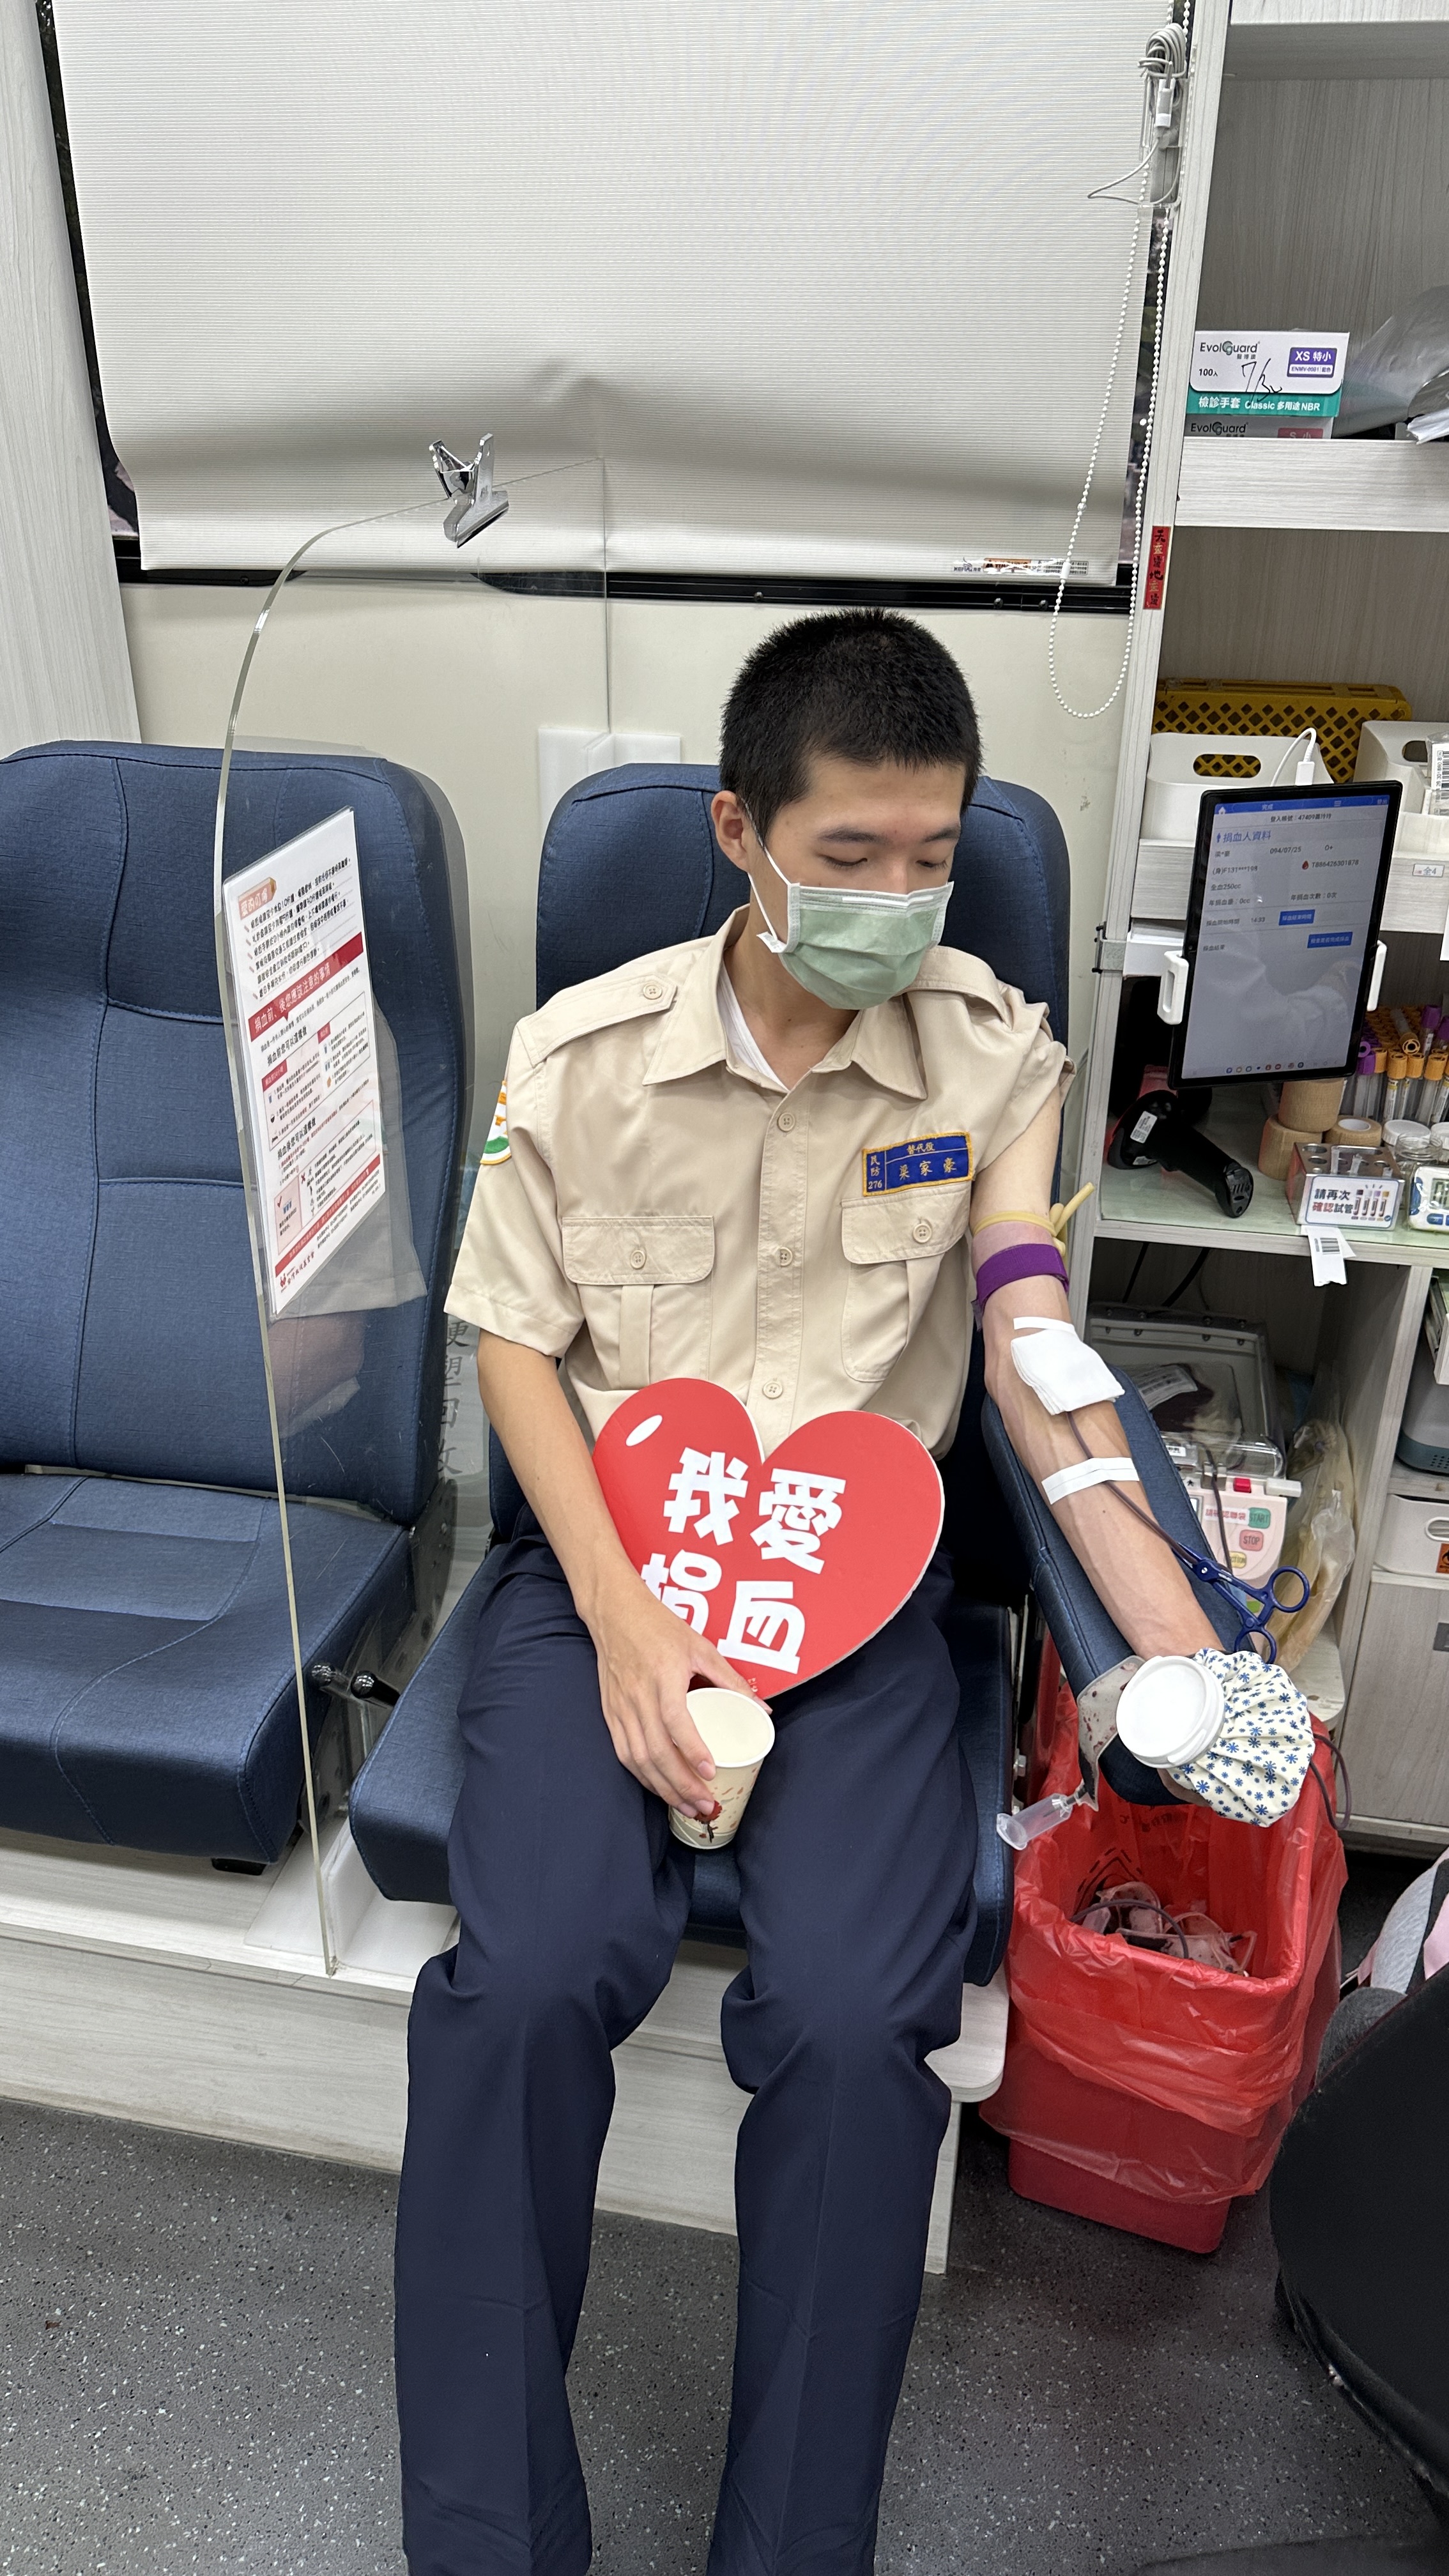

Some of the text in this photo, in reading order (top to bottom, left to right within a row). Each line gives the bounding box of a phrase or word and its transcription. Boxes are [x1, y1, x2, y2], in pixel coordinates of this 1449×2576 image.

[1200, 341, 1257, 355] EvolGuard
[1294, 351, 1331, 362] XS 特小
[1199, 396, 1241, 409] 檢診手套
[1245, 401, 1275, 410] Classic
[1190, 421, 1246, 436] EvolGuard
[1222, 830, 1271, 843] 捐血人資料
[1269, 846, 1301, 854] 094/07/25
[907, 1142, 935, 1155] 替代役
[870, 1155, 881, 1177] 民防
[899, 1157, 957, 1181] 梁家豪
[868, 1180, 882, 1190] 276
[1314, 1188, 1351, 1200] 請再次
[1312, 1202, 1353, 1214] 確認試管
[663, 1446, 847, 1574] 我愛
[1250, 1513, 1269, 1523] START
[1243, 1535, 1261, 1545] STOP
